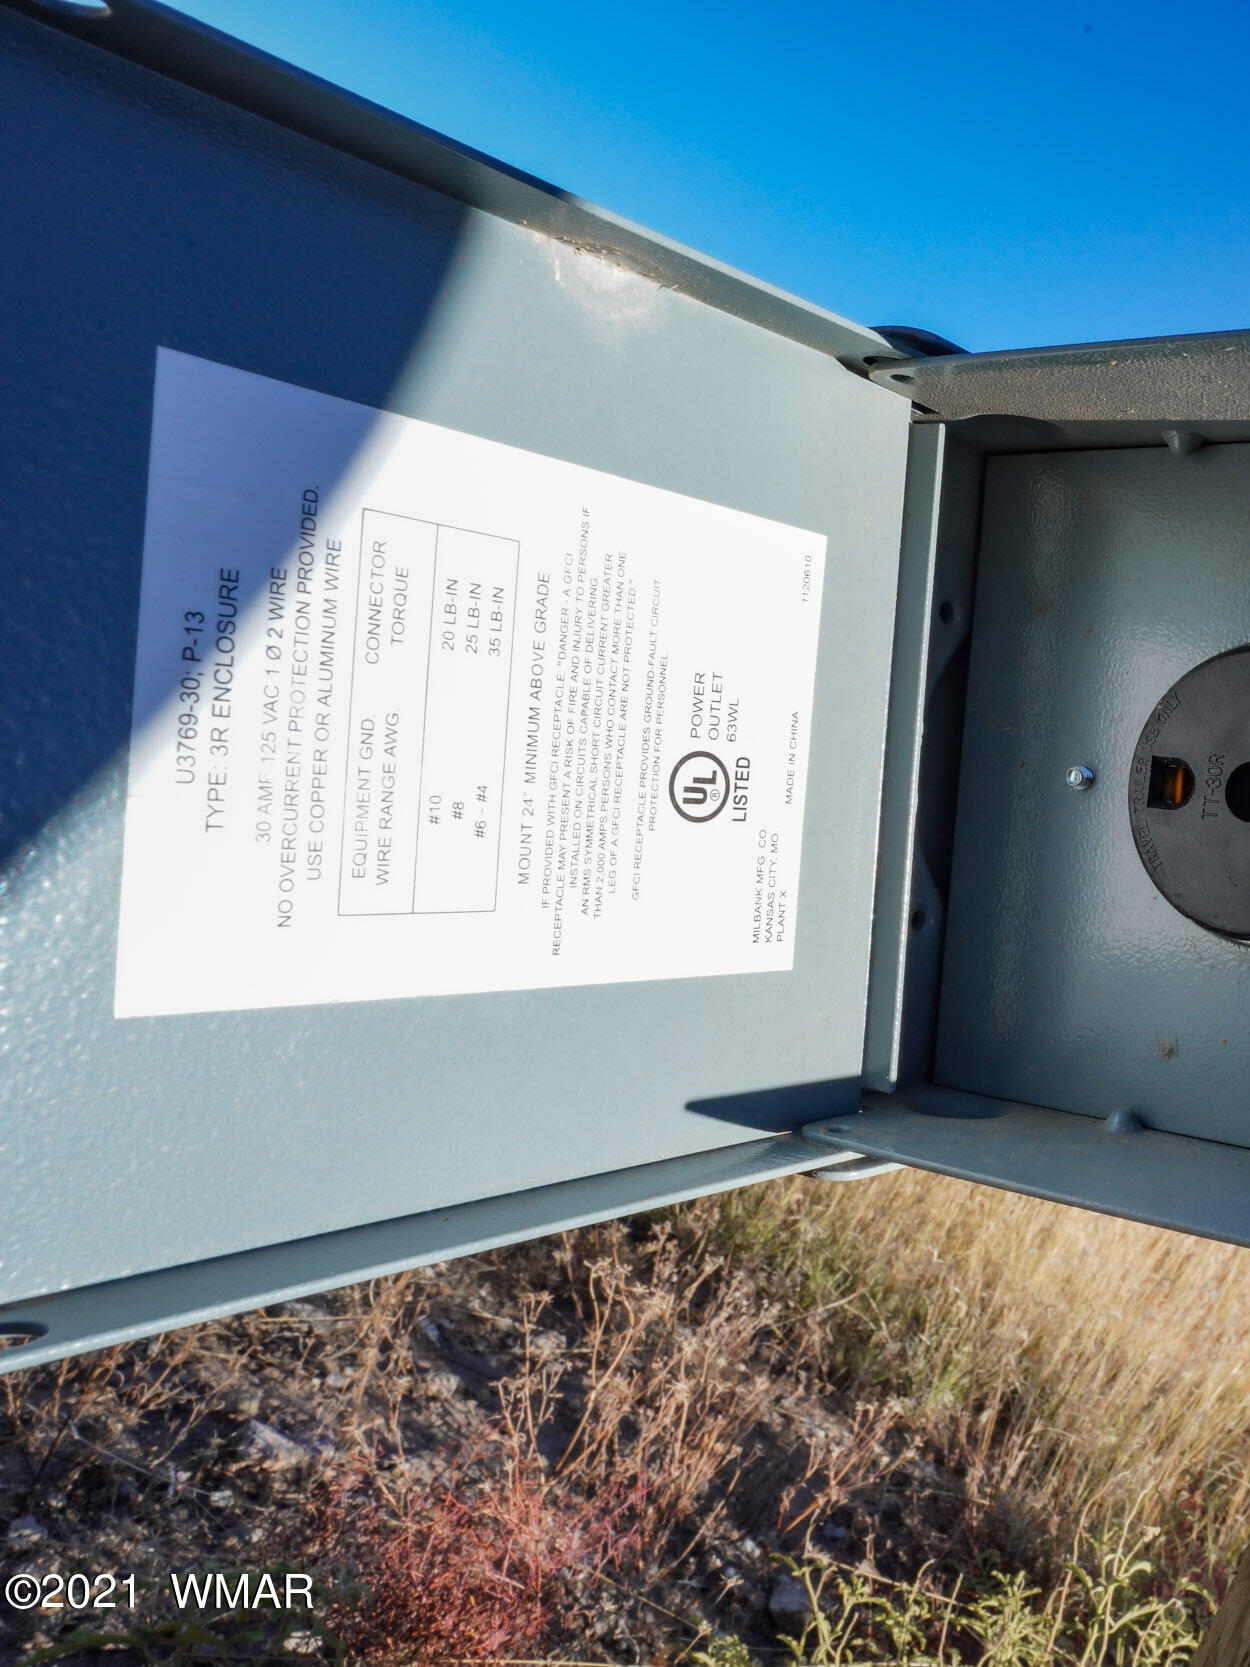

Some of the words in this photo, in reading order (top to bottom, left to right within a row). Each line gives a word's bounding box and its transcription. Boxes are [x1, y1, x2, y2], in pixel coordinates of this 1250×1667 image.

[582, 505, 590, 517] IF
[295, 484, 321, 595] PROVIDED.
[576, 519, 590, 583] PERSONS
[321, 536, 342, 592] WIRE
[601, 552, 613, 612] GREATER
[801, 554, 812, 602] 1120610
[267, 566, 288, 623] WIRE
[363, 539, 387, 665] CONNECTOR
[390, 565, 409, 647] TORQUE
[442, 577, 459, 625] LB-IN
[466, 581, 482, 628] LB-IN
[489, 585, 505, 632] LB-IN
[533, 571, 550, 634] GRADE
[575, 585, 585, 604] TO
[584, 576, 598, 653] DELIVERING
[650, 579, 661, 627] CIRCUIT
[184, 609, 206, 664] P-13
[208, 566, 240, 718] ENCLOSURE
[266, 627, 284, 639] 2
[315, 597, 339, 707] ALUMINUM
[440, 629, 456, 651] 20
[464, 633, 479, 654] 25
[487, 636, 501, 656] 35
[571, 606, 585, 652] INJURY
[596, 614, 609, 675] CURRENT
[264, 668, 280, 677] 1
[287, 599, 312, 732] PROTECTION
[528, 639, 546, 701] ABOVE
[569, 654, 580, 682] AND
[582, 656, 593, 674] OF
[643, 630, 658, 723] GROUND-FAULT
[261, 684, 280, 725] VAC
[567, 684, 578, 713] FIRE
[579, 677, 591, 734] CAPABLE
[592, 678, 604, 727] CIRCUIT
[689, 671, 706, 738] POWER
[707, 670, 724, 740] OUTLET
[725, 696, 739, 742] 63WL
[176, 668, 202, 784] U3769-30;
[209, 726, 230, 756] 3R
[259, 730, 277, 762] 125
[313, 711, 331, 742] OR
[382, 707, 399, 757] AWG.
[523, 705, 541, 784] MINIMUM
[566, 717, 575, 734] OF
[788, 710, 799, 749] CHINA
[562, 769, 572, 778] A
[563, 737, 574, 767] RISK
[574, 737, 587, 796] CIRCUITS
[589, 730, 601, 773] SHORT
[638, 726, 651, 787] PROVIDES
[788, 753, 795, 764] IN
[307, 747, 329, 833] COPPER
[378, 762, 397, 829] RANGE
[426, 794, 442, 824] #10
[451, 801, 464, 820] #8
[475, 784, 488, 802] #4
[558, 781, 572, 840] PRESENT
[573, 799, 583, 818] ON
[730, 755, 751, 822] LISTED
[784, 769, 795, 804] MADE
[1200, 753, 1226, 820] TT-30R
[254, 820, 272, 842] 30
[277, 737, 304, 892] OVERCURRENT
[350, 765, 374, 878] EQUIPMENT
[472, 817, 488, 838] #6
[582, 776, 598, 864] SYMMETRICAL
[632, 791, 647, 868] RECEPTACLE
[305, 840, 324, 880] USE
[374, 836, 392, 885] WIRE
[516, 821, 533, 884] MOUNT
[557, 844, 567, 870] MAY
[568, 822, 582, 887] INSTALLED
[755, 852, 766, 883] MFG.
[581, 868, 591, 894] RMS
[631, 872, 641, 900] GFCI
[275, 899, 294, 927] NO
[551, 874, 566, 955] RECEPTACLE
[580, 898, 589, 915] AN
[750, 887, 764, 943] MILBANK
[763, 891, 776, 942] KANSAS
[775, 901, 786, 942] PLANT
